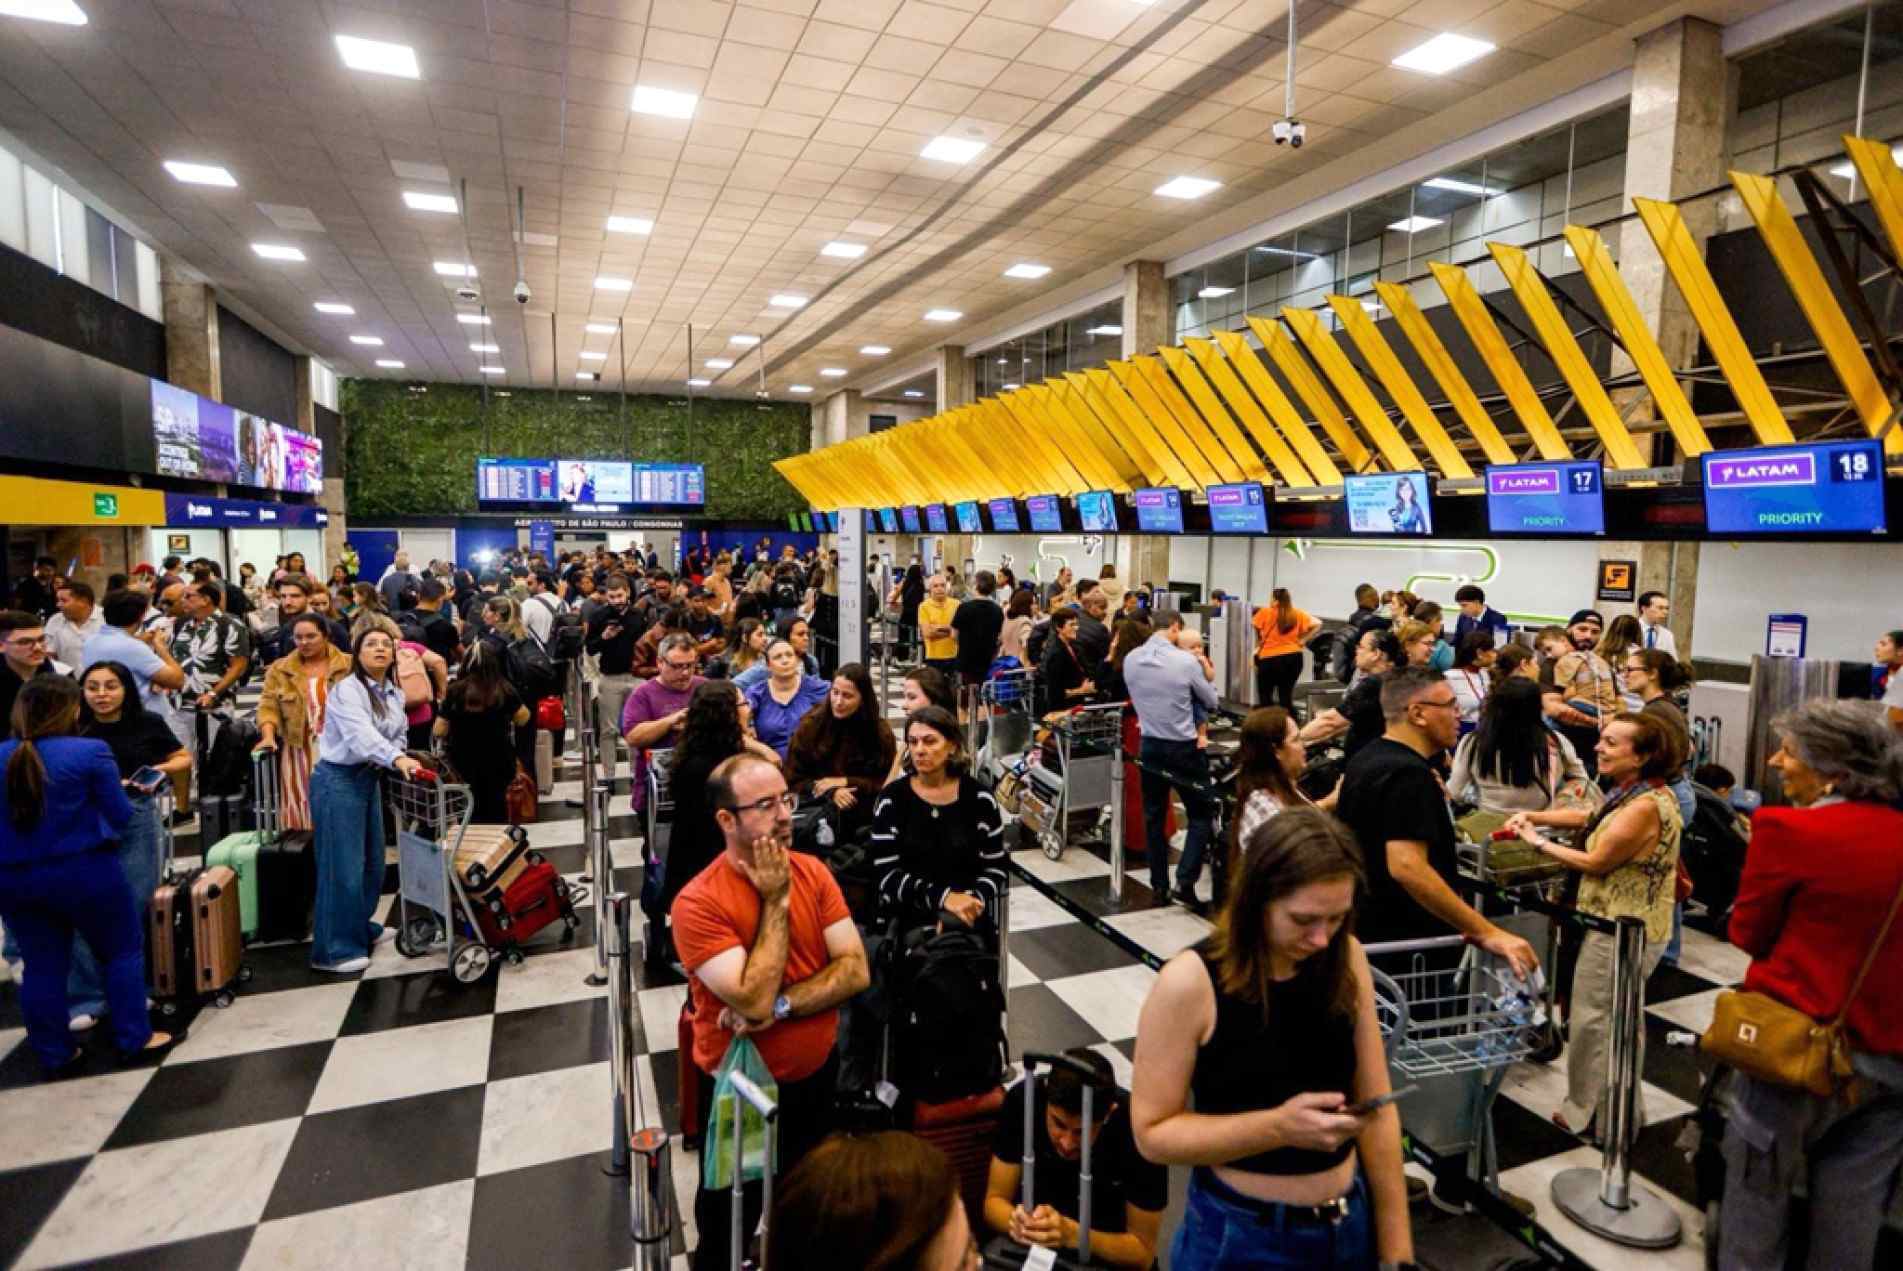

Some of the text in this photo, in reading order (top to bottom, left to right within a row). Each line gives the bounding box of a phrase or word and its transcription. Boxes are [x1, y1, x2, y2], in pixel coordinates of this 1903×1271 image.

[1736, 463, 1799, 478] LATAM
[1839, 453, 1869, 473] 18
[1574, 471, 1592, 486] 17
[1759, 512, 1823, 525] PRIORITY
